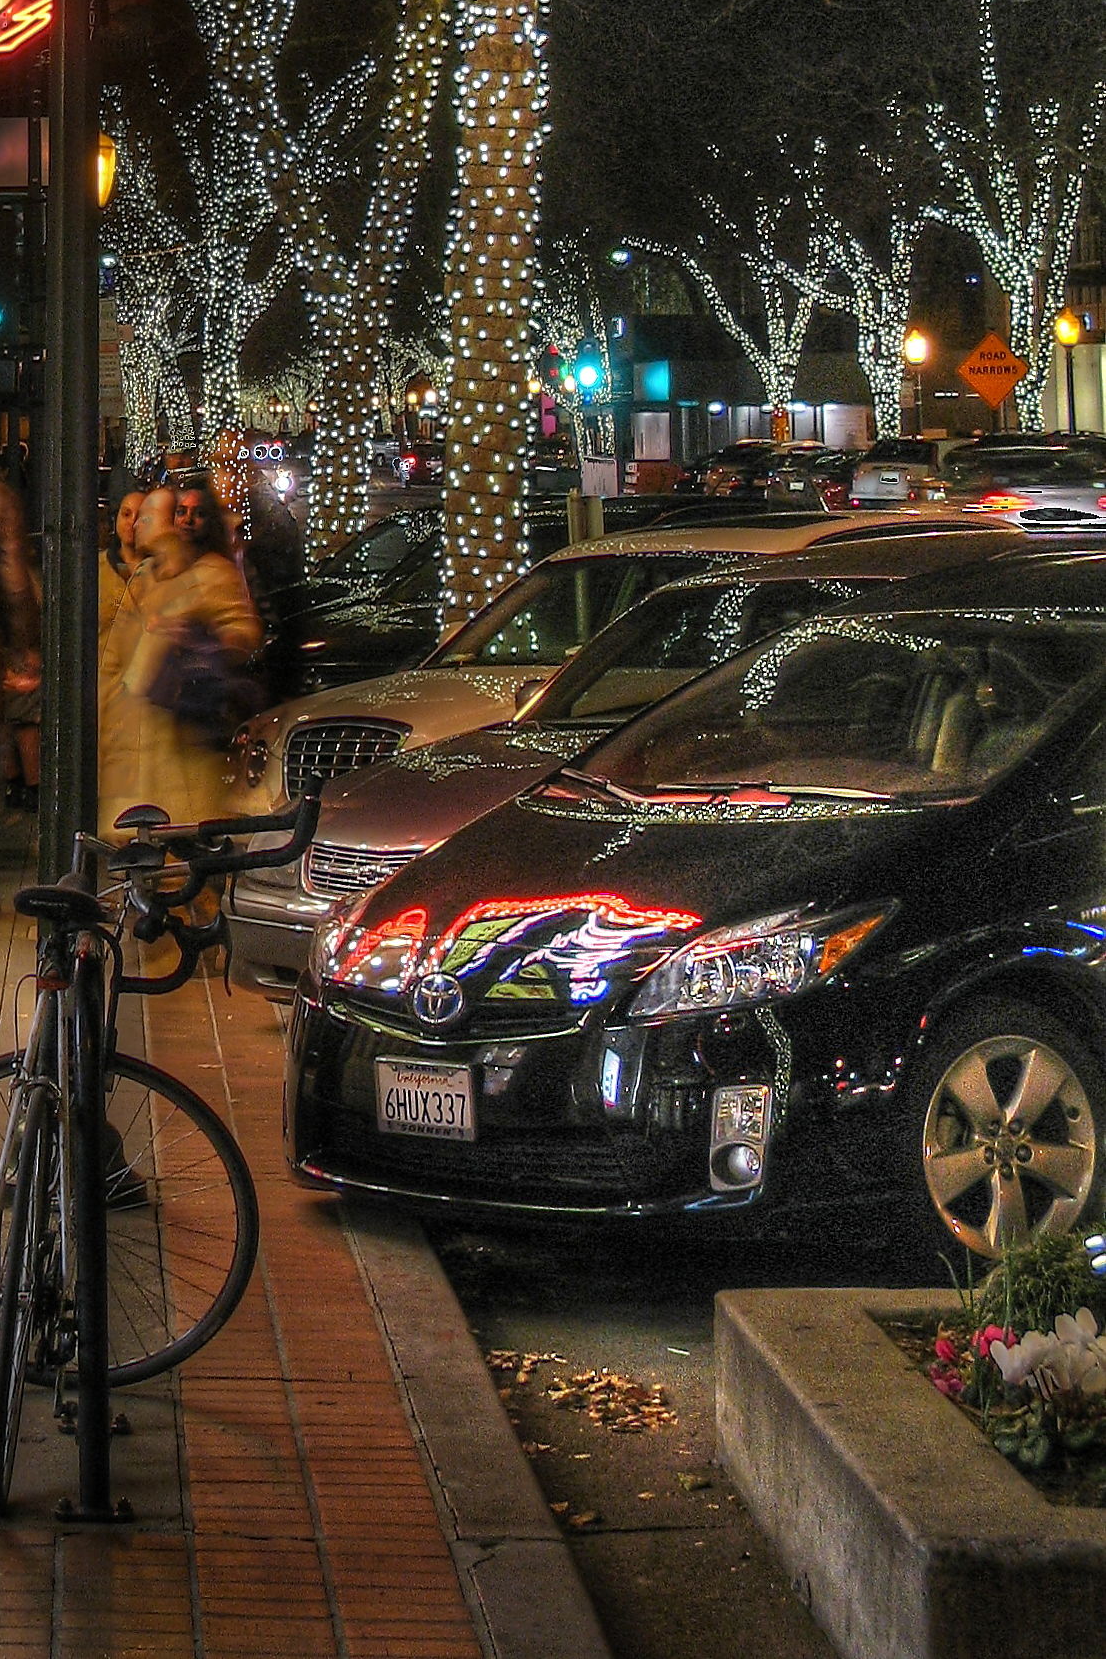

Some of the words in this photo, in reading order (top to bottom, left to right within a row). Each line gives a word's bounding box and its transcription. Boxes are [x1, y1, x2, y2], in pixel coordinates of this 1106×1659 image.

[979, 351, 1007, 361] ROAD
[968, 365, 1018, 375] NARROWS
[385, 1087, 466, 1127] 6HUX337
